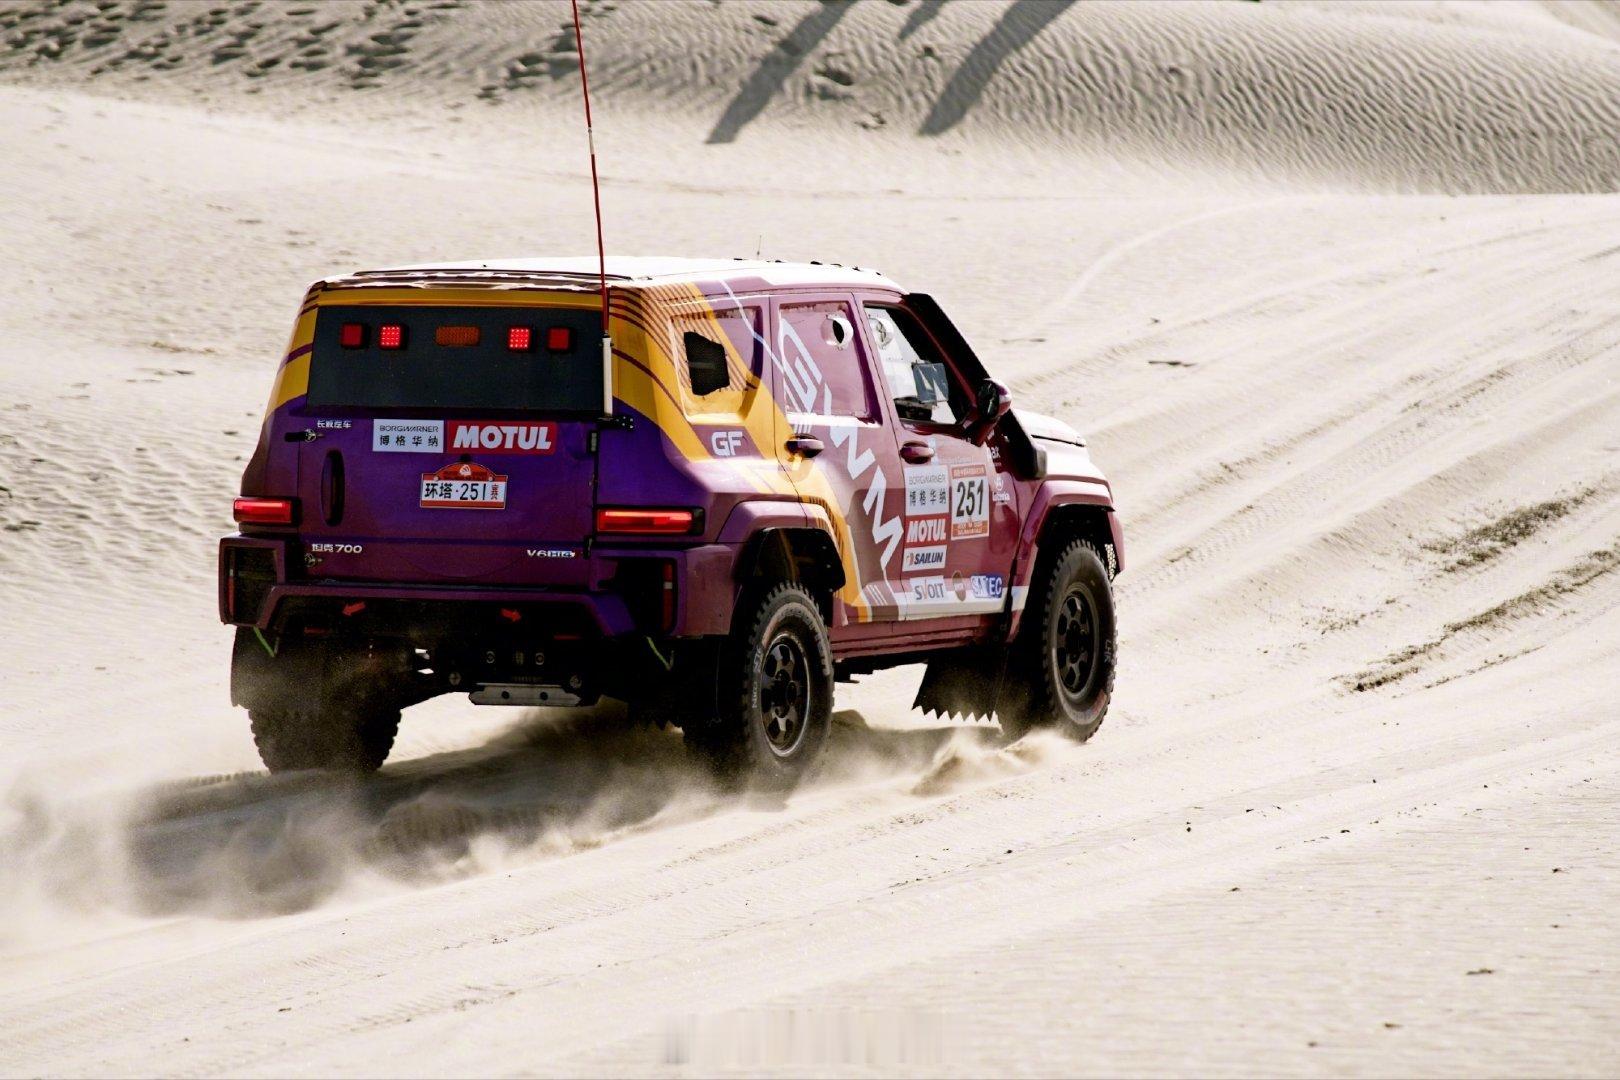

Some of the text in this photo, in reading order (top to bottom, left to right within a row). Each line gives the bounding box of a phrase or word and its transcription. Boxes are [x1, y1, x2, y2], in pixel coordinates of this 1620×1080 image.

[379, 425, 439, 433] BORGWARNER
[453, 425, 551, 450] MOTUL
[379, 435, 439, 447] 博格华纳
[711, 431, 743, 456] GF
[956, 479, 984, 517] 251
[907, 518, 946, 543] MOTUL
[335, 544, 363, 553] 700
[914, 552, 944, 565] SAILUN
